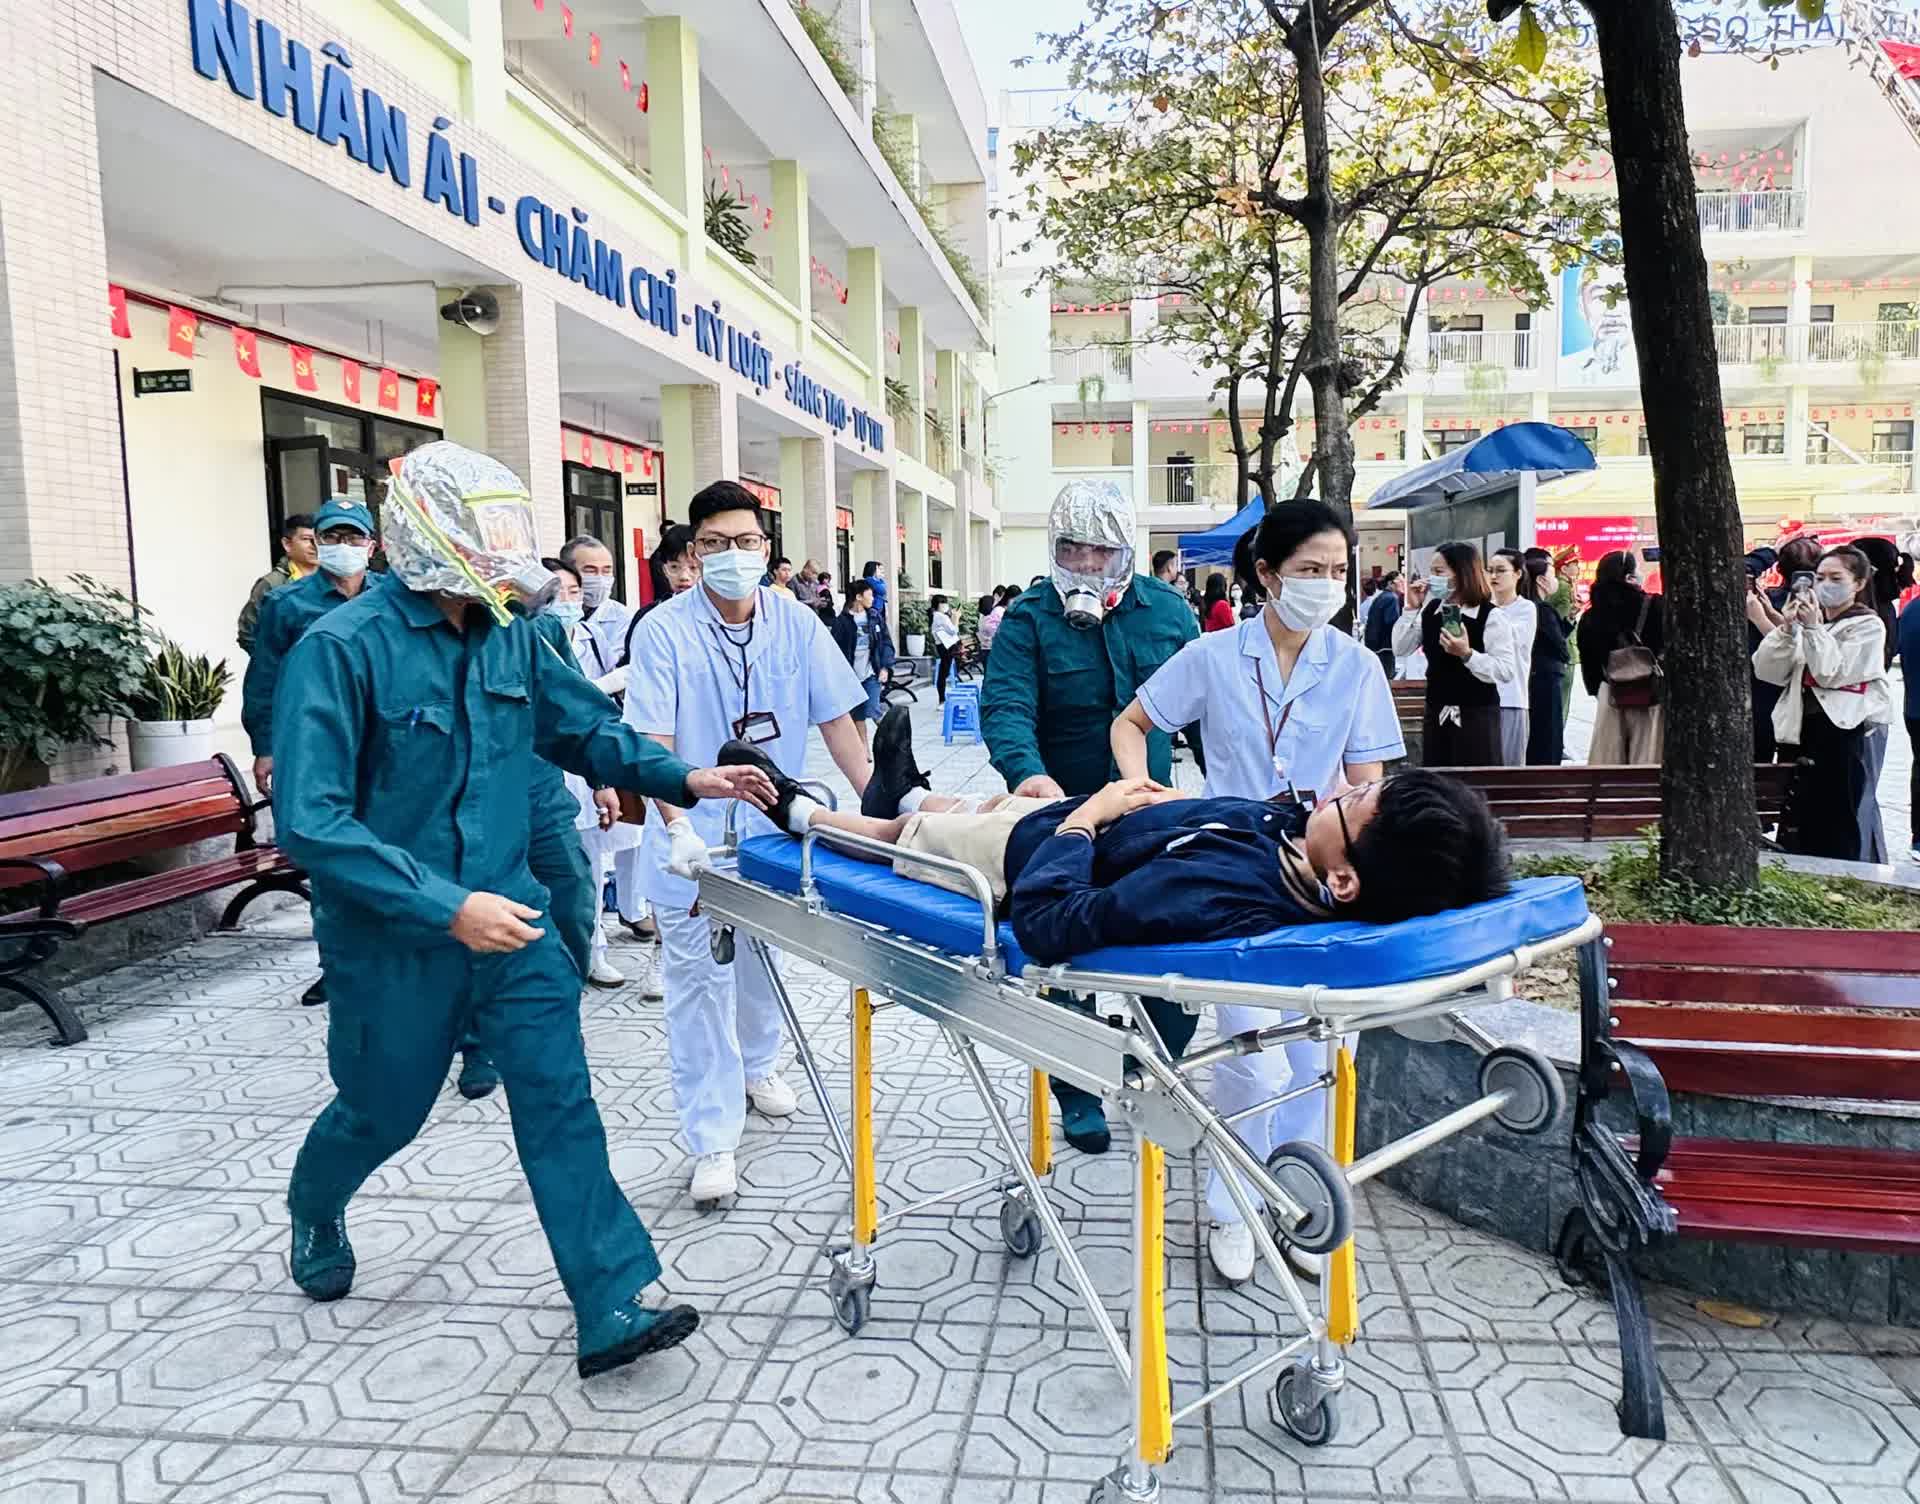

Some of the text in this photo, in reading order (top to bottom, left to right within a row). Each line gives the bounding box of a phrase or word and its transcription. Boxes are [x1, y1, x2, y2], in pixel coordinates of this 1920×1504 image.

[188, 0, 411, 188] NHÂN
[423, 116, 480, 227] ÁI
[516, 196, 626, 308] CHĂM
[630, 268, 678, 337] CHỈ
[695, 300, 725, 362] KỶ
[728, 325, 773, 396] LUẬT
[784, 360, 823, 419] SÁNG
[823, 388, 847, 436] TẠO
